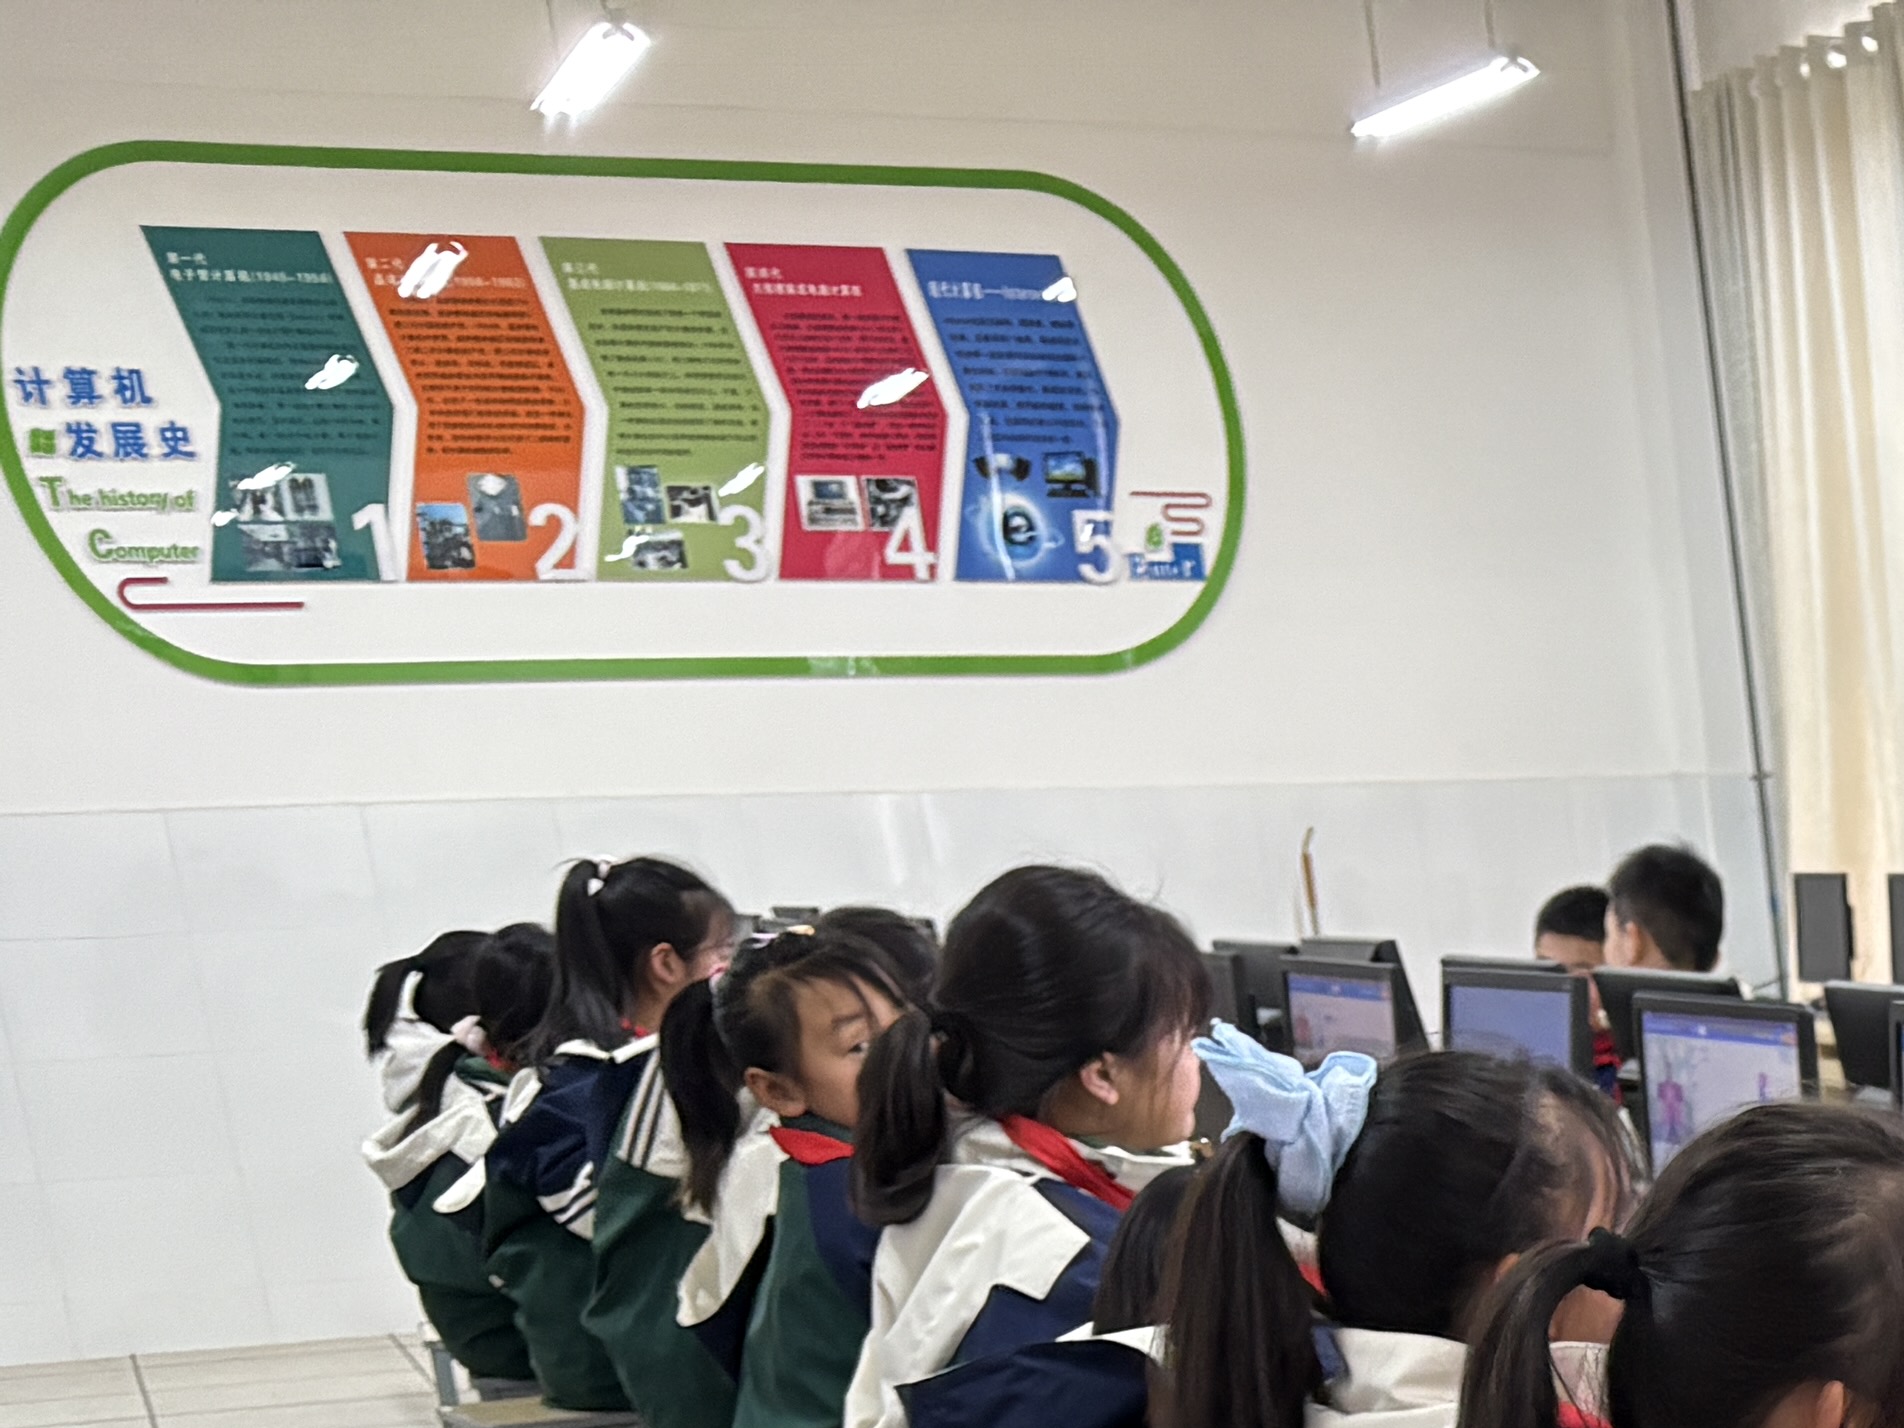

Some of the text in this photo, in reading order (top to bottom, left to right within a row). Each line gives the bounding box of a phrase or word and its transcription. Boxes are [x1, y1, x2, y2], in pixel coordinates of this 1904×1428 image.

[13, 366, 154, 406] 计算机
[65, 421, 198, 460] 发展史
[38, 476, 197, 511] The history of
[88, 529, 200, 562] Computer
[351, 502, 399, 581] 1
[527, 503, 590, 580] 2
[720, 504, 770, 582] 3
[883, 507, 936, 582] 4
[1071, 508, 1119, 585] 5
